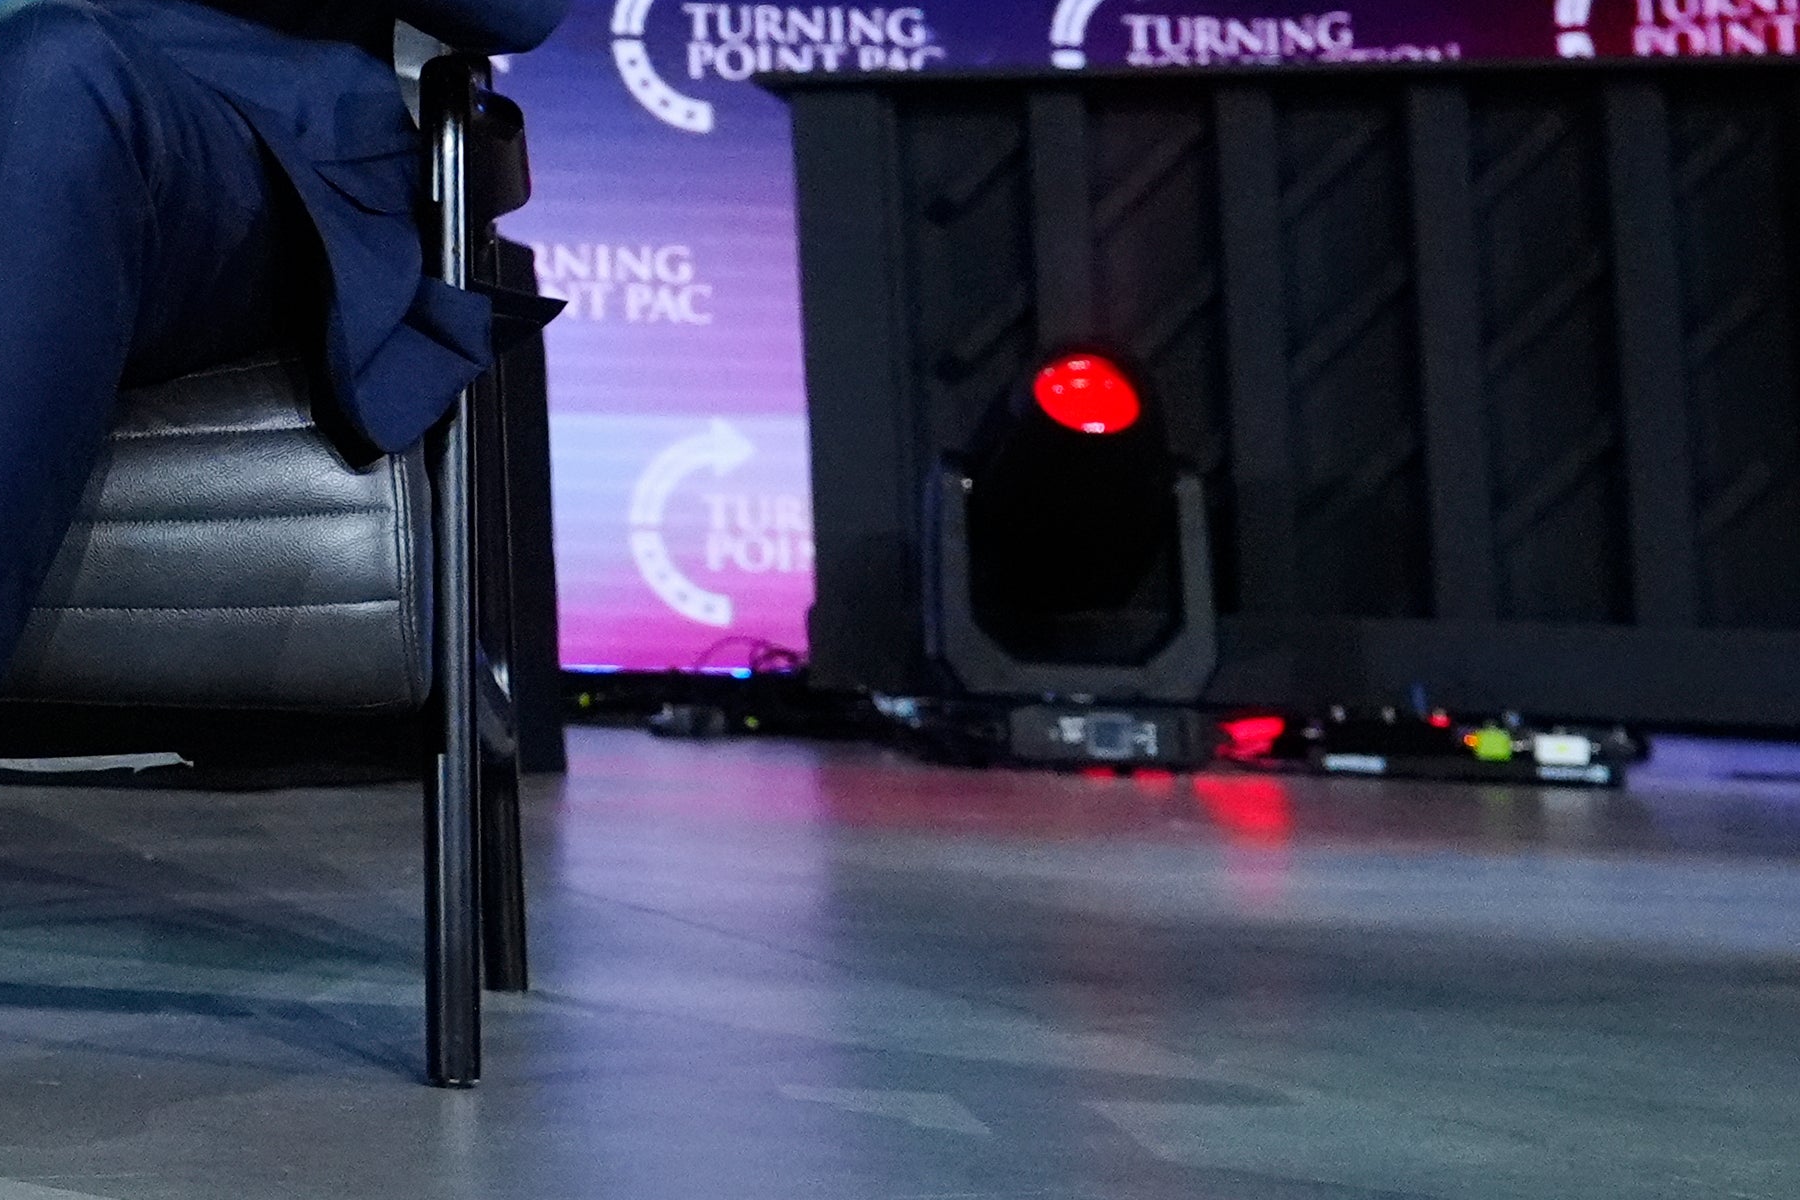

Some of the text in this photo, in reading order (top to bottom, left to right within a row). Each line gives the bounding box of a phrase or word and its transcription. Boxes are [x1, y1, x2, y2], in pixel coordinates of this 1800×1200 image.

[681, 3, 927, 47] TURNING
[1121, 11, 1353, 52] TURNING
[687, 40, 847, 81] POINT
[626, 283, 713, 326] PAC
